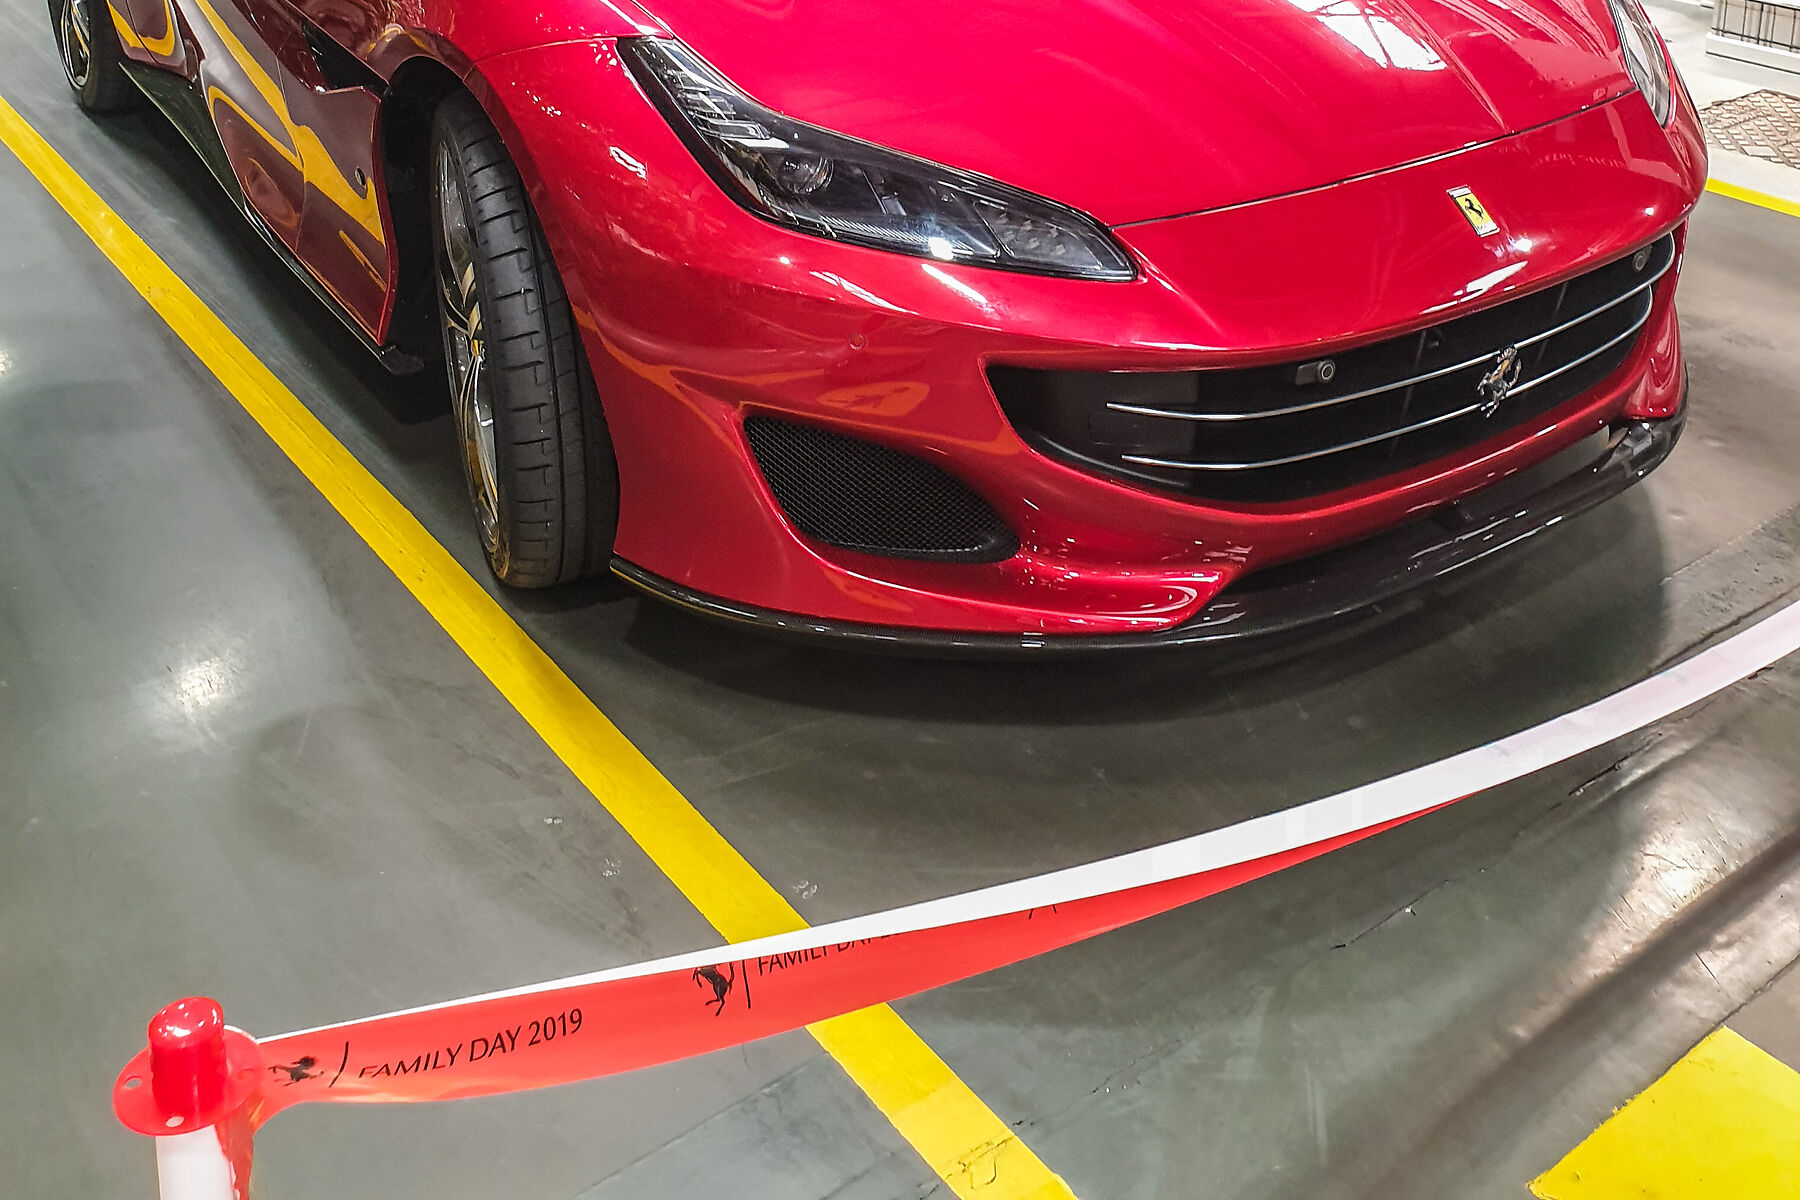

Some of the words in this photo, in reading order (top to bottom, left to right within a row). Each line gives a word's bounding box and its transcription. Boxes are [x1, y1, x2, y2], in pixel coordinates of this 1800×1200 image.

[359, 1043, 462, 1079] FAMILY
[469, 1025, 521, 1063] DAY
[528, 1008, 583, 1047] 2019
